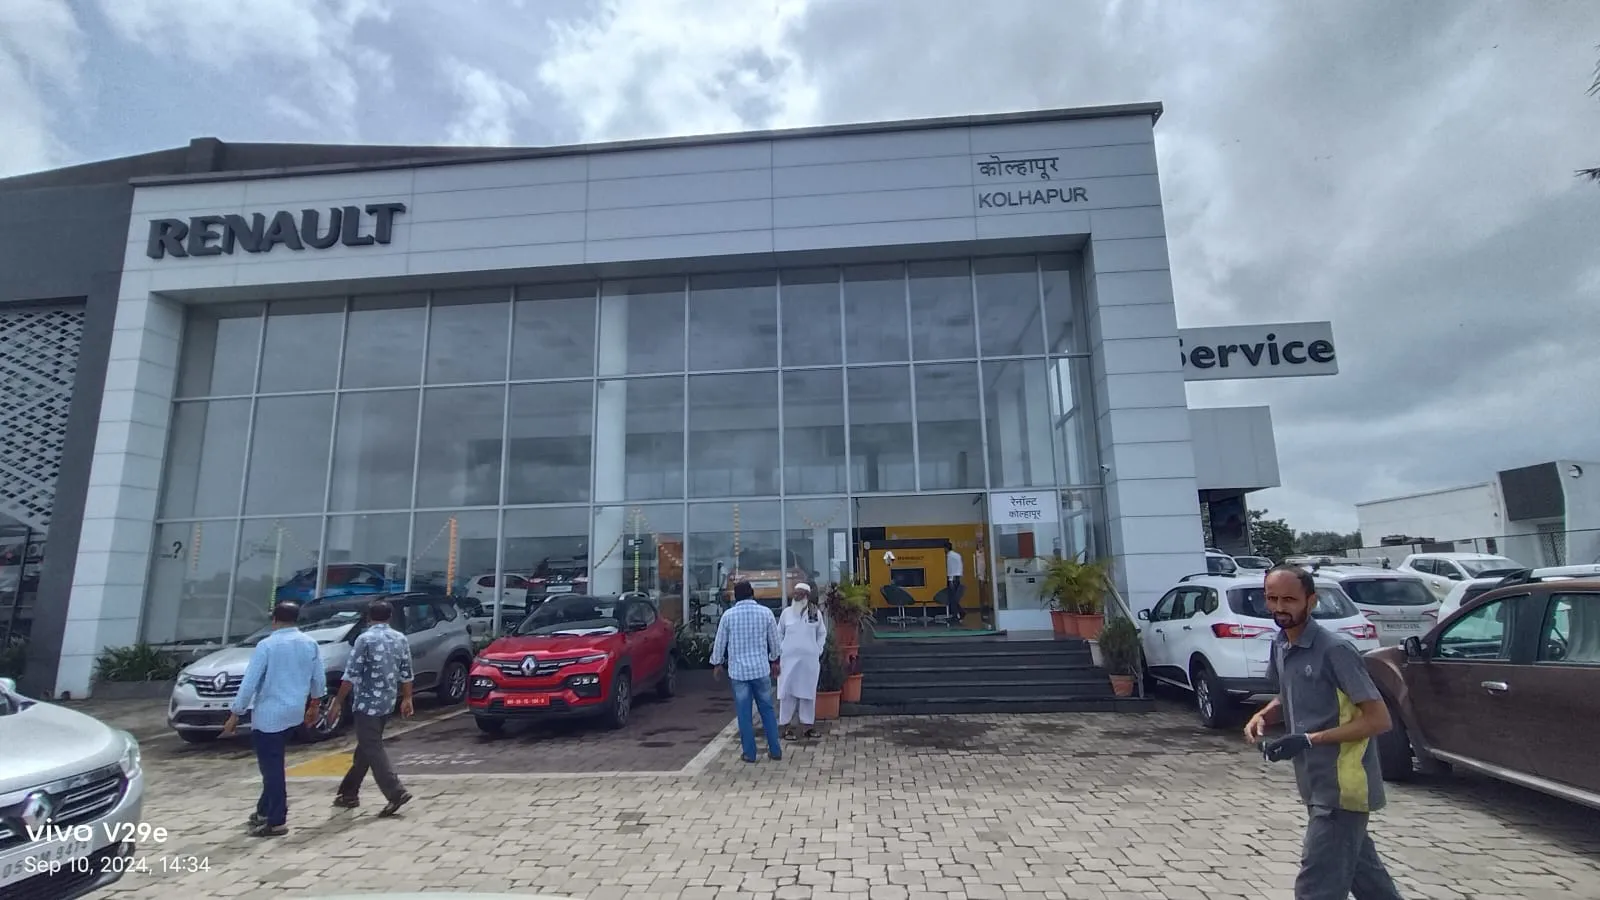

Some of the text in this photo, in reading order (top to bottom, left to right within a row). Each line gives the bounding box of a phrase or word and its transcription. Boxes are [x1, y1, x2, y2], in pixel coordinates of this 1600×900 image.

[977, 155, 1059, 180] कोल्हापूर
[978, 186, 1089, 209] KOLHAPUR
[146, 202, 406, 259] RENAULT
[1008, 508, 1042, 520] कोल्हापूर
